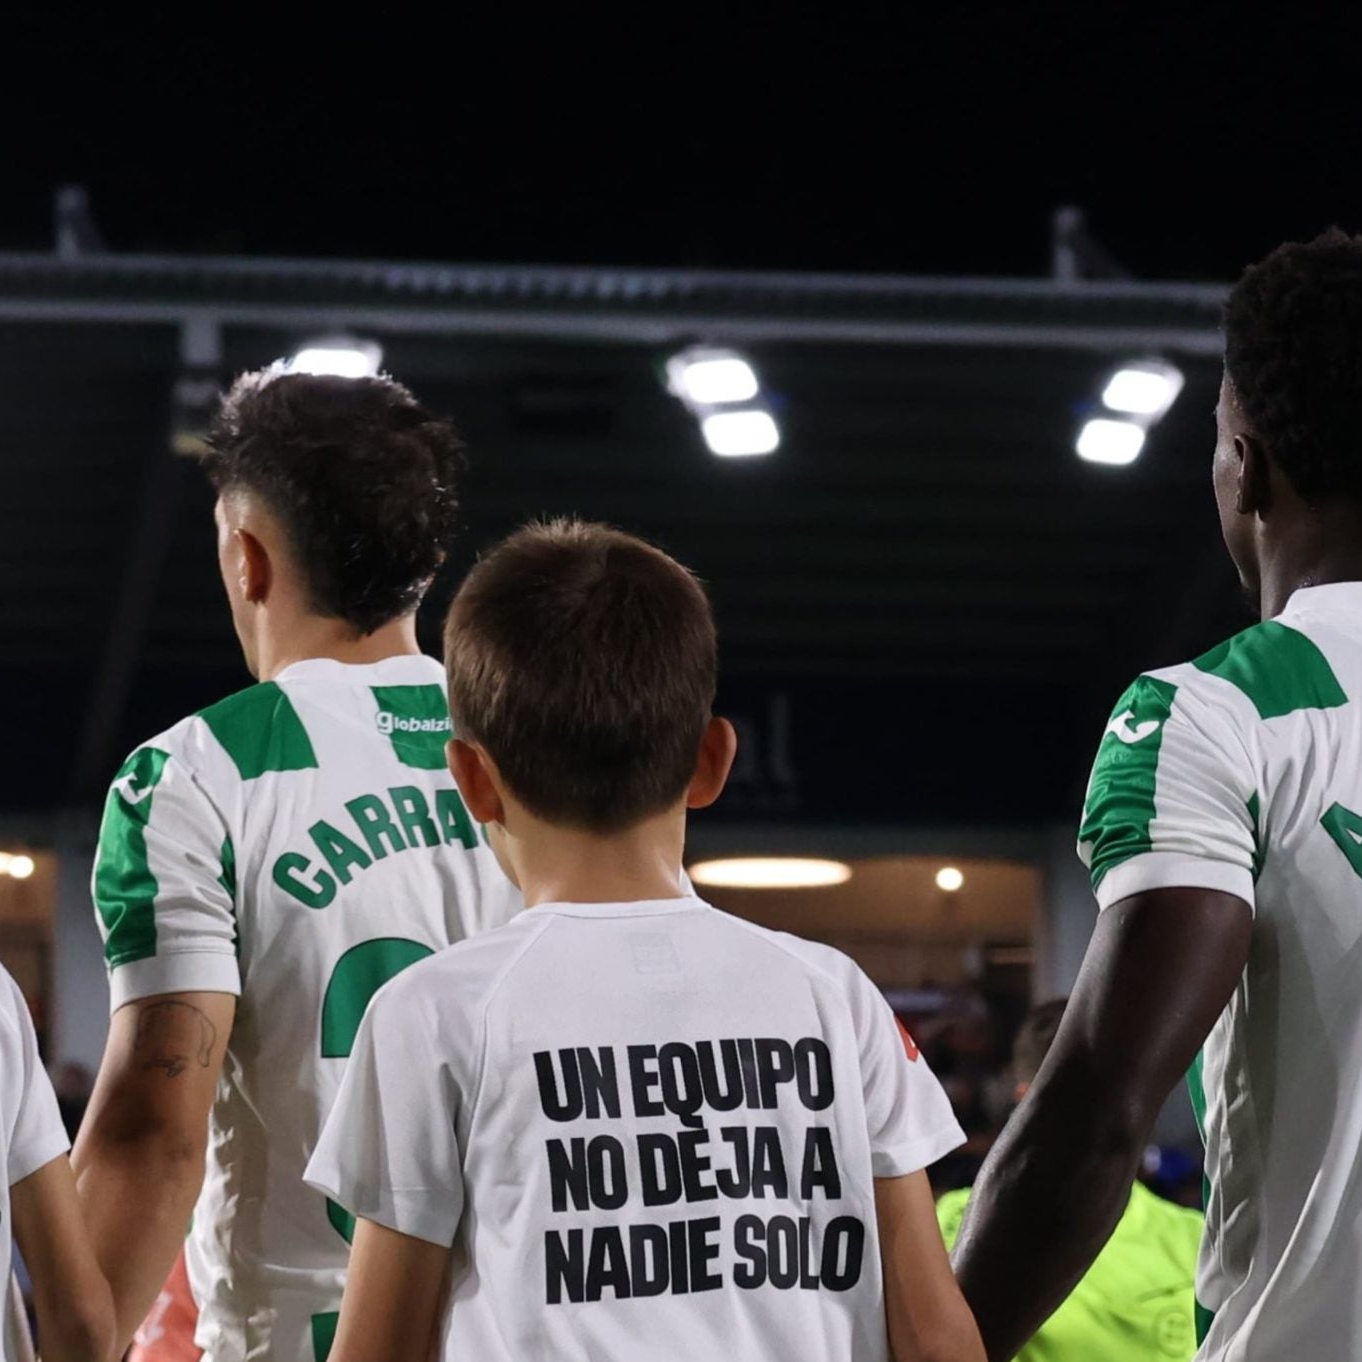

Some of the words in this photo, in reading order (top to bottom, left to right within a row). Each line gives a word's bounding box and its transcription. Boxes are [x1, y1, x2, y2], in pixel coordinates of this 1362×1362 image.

[272, 785, 491, 910] CARRA
[533, 1046, 621, 1122] UN
[627, 1037, 835, 1129] EQUIPO
[546, 1135, 629, 1212] NO
[636, 1126, 788, 1207] DEJA
[801, 1127, 842, 1200] A
[545, 1216, 723, 1305] NADIE
[733, 1214, 865, 1292] SOLO
